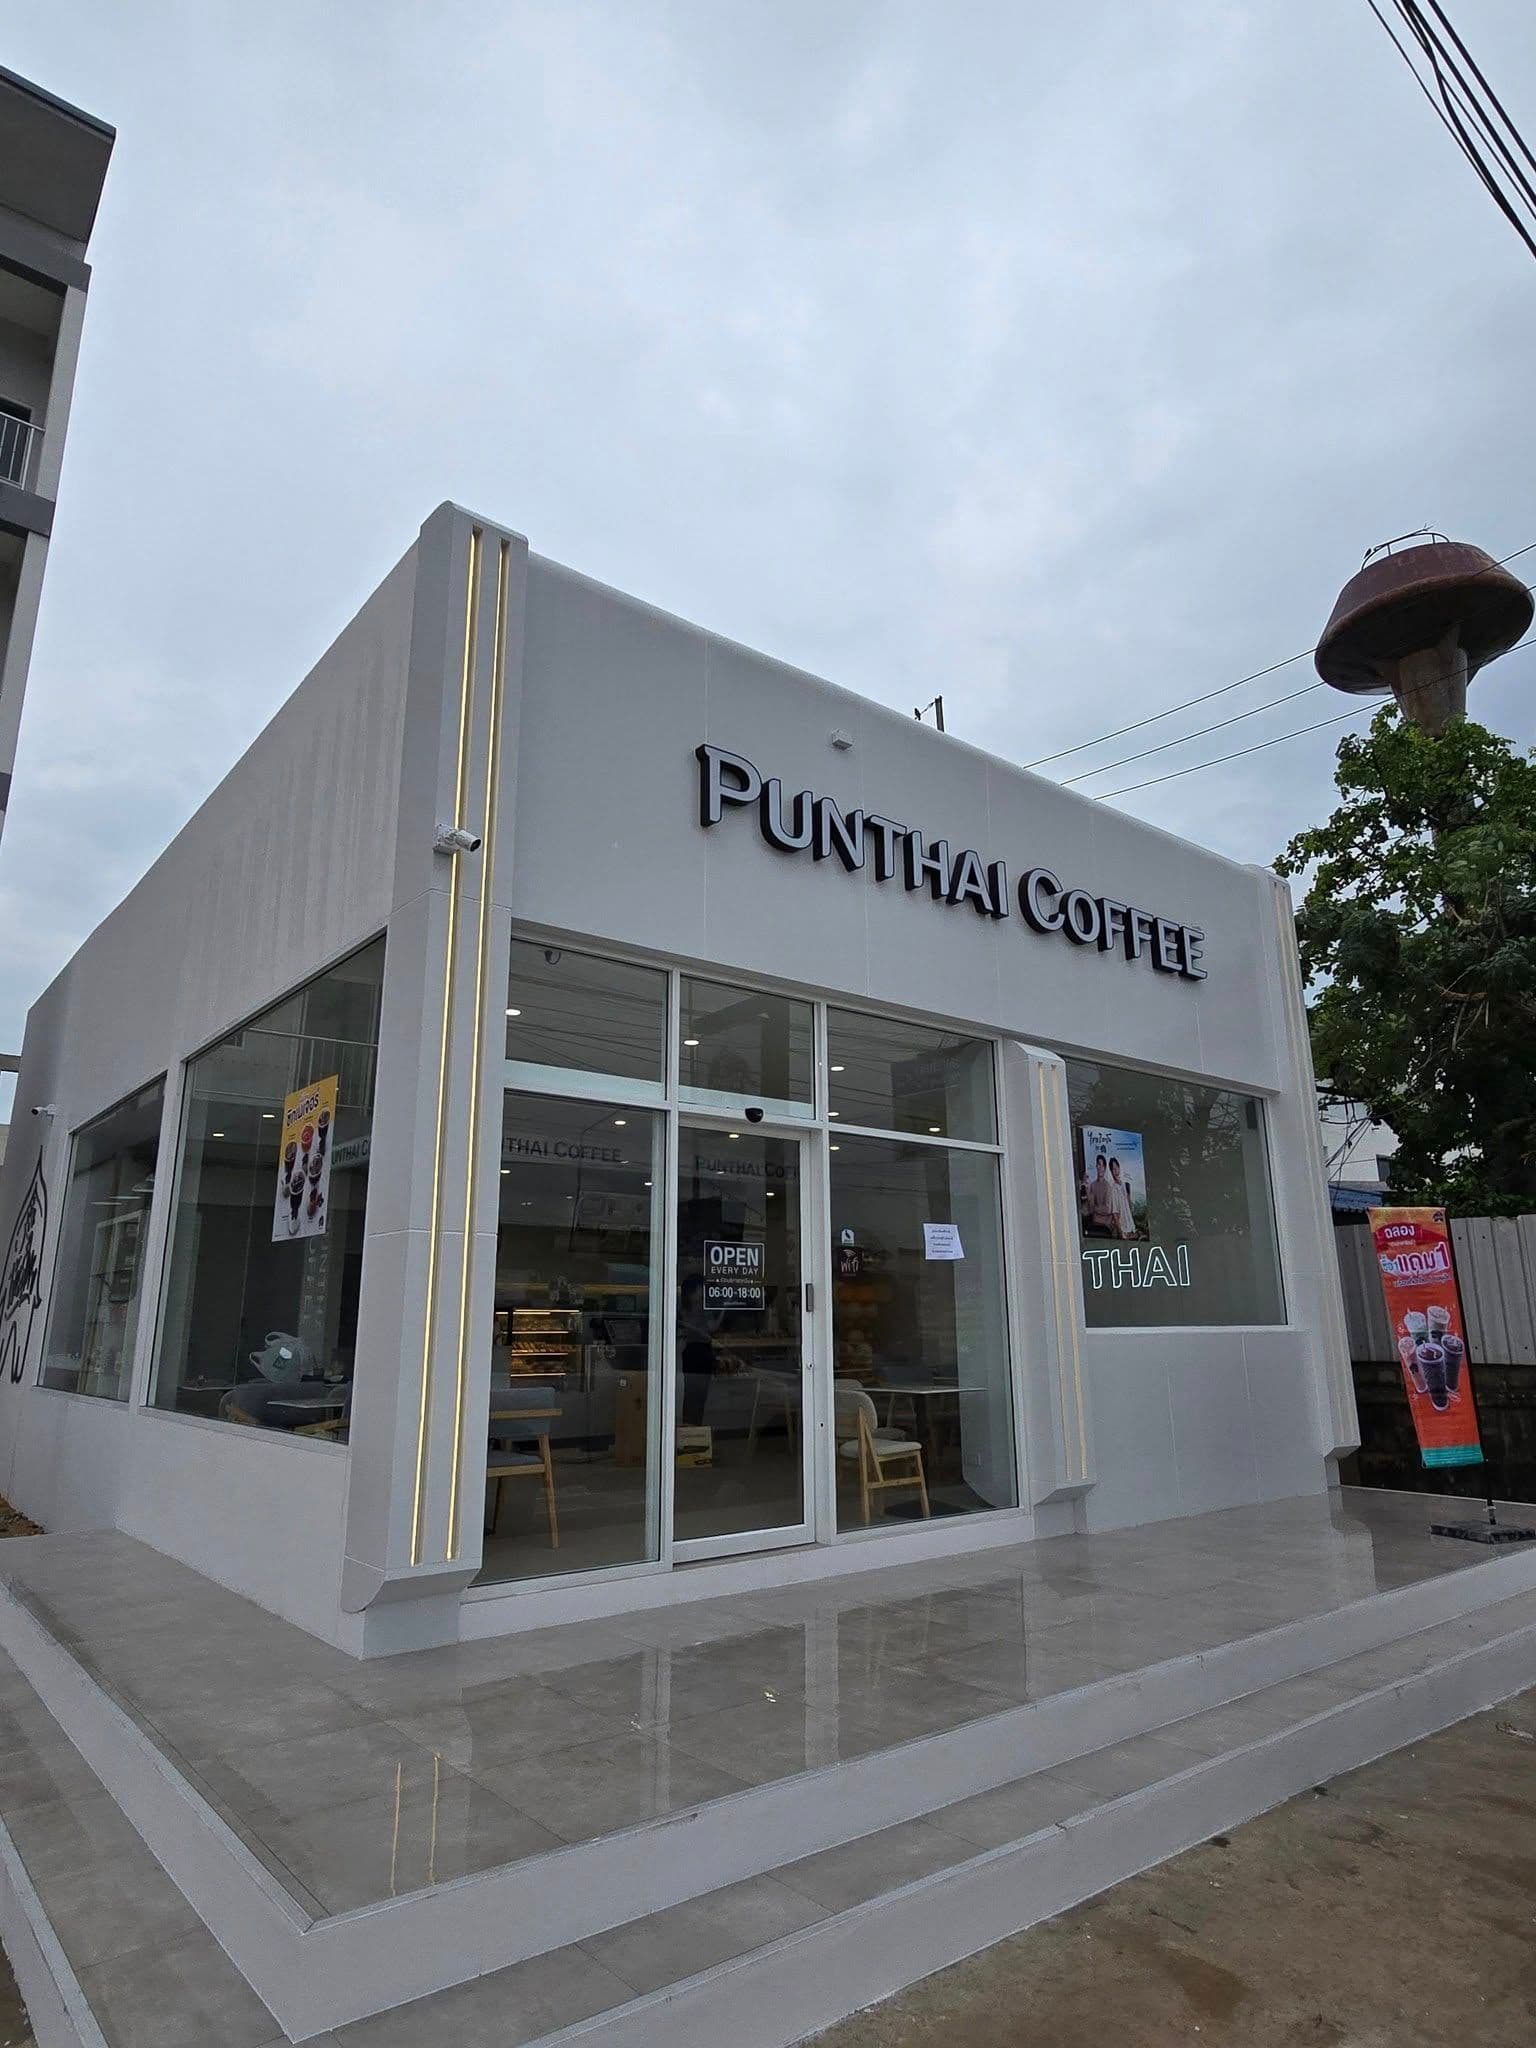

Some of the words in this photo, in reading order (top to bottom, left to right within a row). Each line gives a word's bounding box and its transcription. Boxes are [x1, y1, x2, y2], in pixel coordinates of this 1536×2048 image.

[695, 743, 1010, 919] PUNTHAI
[1018, 868, 1209, 981] COFFEE
[710, 1246, 759, 1266] OPEN
[711, 1266, 739, 1275] EVERY
[742, 1267, 759, 1275] DAY
[1082, 1245, 1192, 1290] THAI
